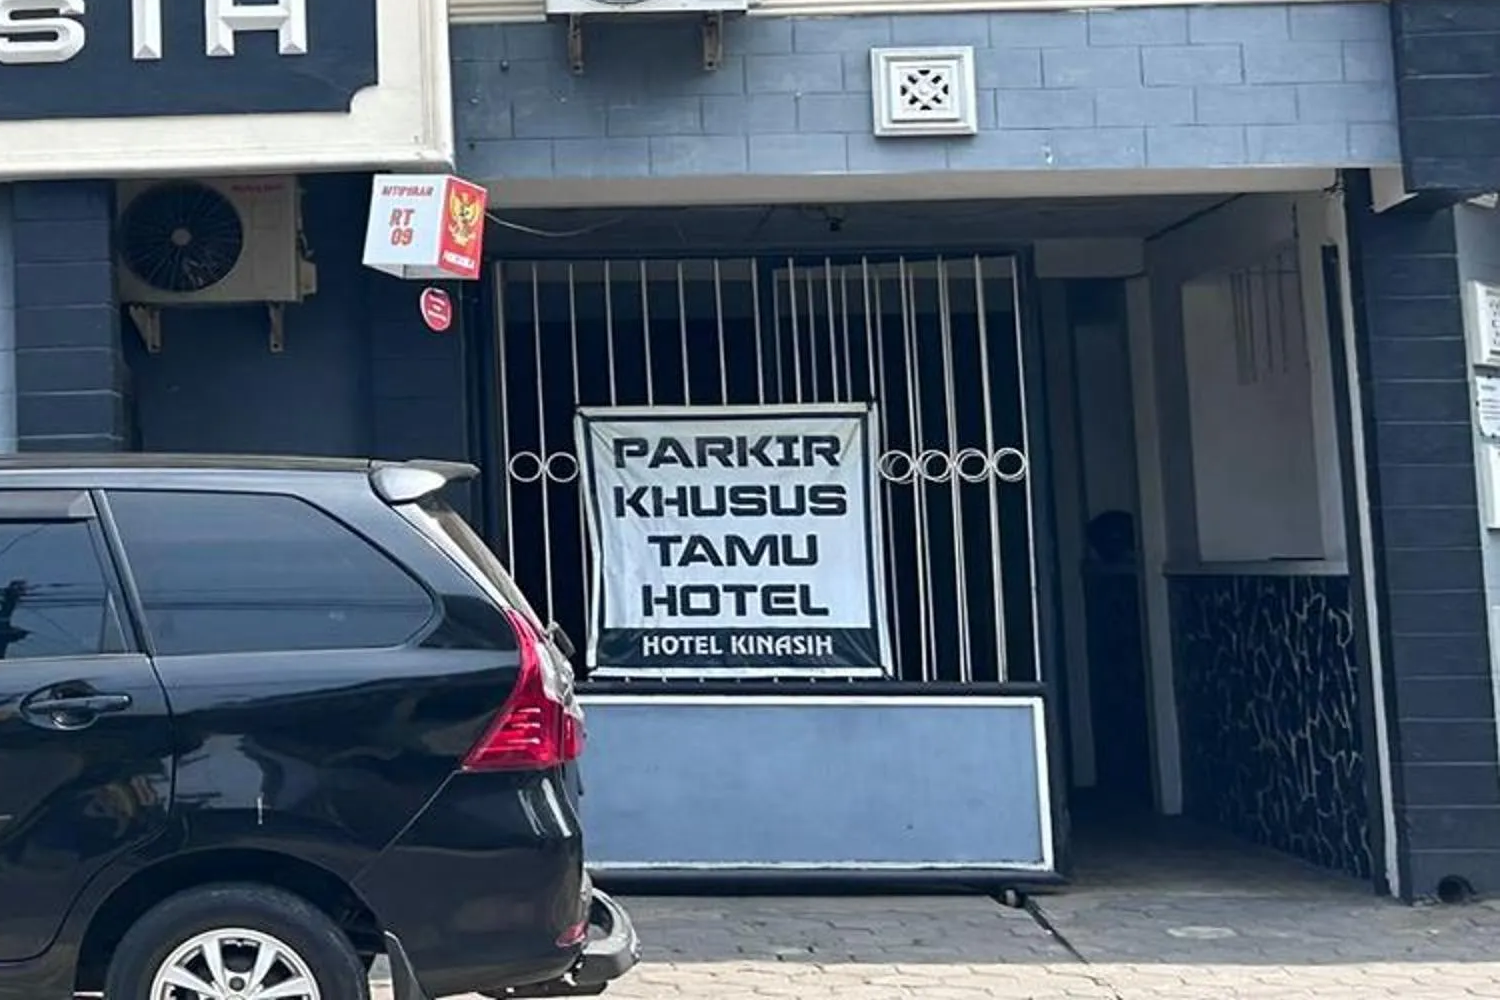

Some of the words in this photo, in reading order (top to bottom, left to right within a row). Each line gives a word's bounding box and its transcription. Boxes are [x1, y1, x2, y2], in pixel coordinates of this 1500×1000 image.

[389, 208, 415, 227] RT
[613, 435, 842, 468] PARKIR
[613, 485, 847, 518] KHUSUS
[647, 534, 819, 567] TAMU
[642, 584, 830, 617] HOTEL
[642, 635, 723, 657] HOTEL
[730, 635, 833, 657] KINASIH
